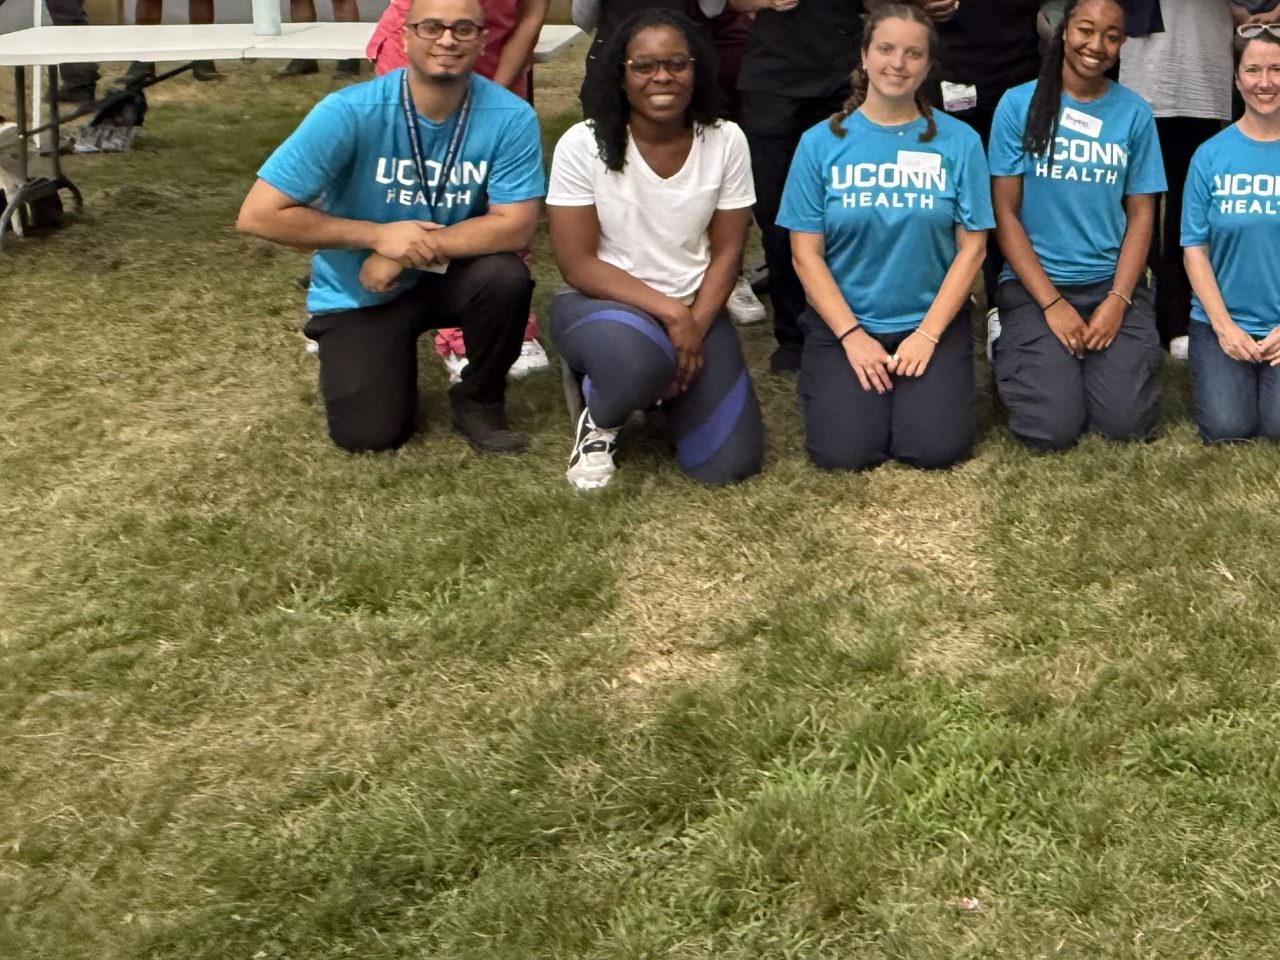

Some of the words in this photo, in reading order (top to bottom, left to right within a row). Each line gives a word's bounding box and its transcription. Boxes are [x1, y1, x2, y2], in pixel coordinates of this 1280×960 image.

[831, 162, 947, 191] UCONN
[1035, 162, 1118, 185] HEALTH
[842, 192, 934, 209] HEALTH
